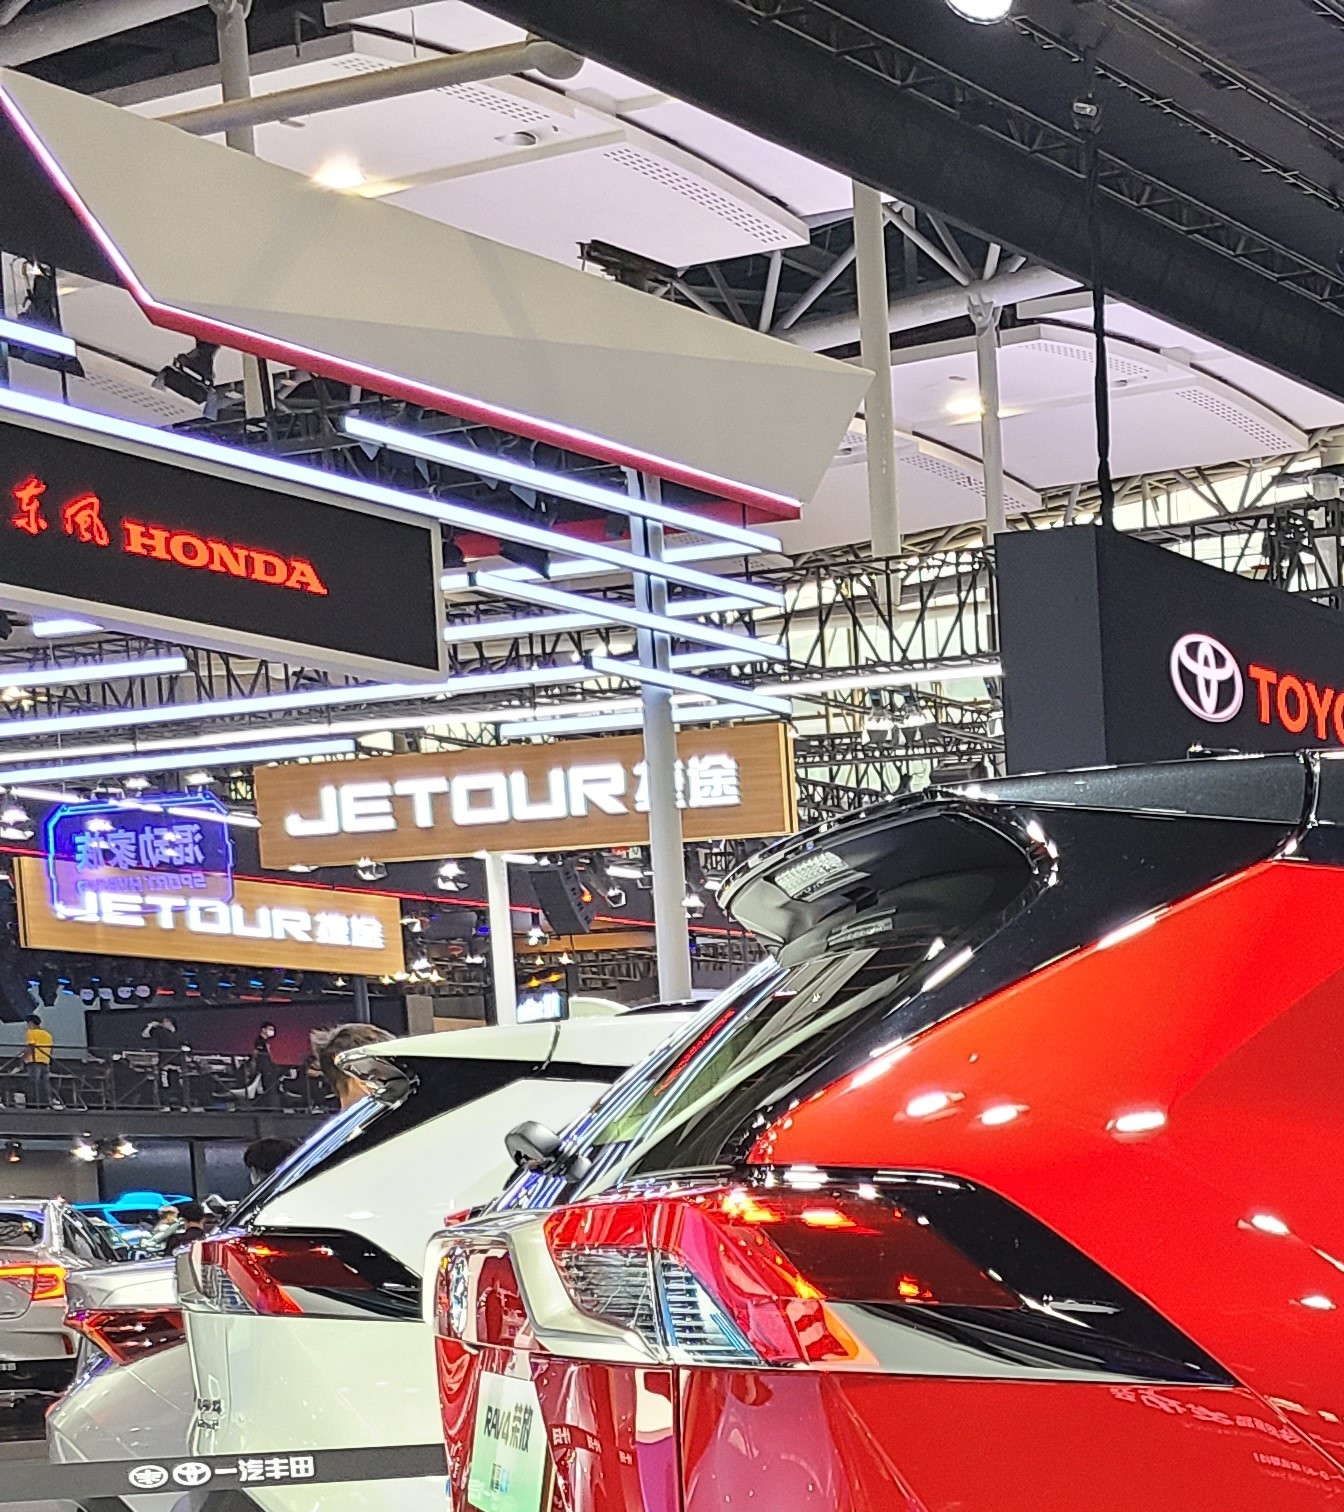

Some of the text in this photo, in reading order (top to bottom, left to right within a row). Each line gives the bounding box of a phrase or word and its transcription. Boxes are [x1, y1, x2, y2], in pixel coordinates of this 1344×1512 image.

[122, 519, 329, 595] HONDA
[285, 762, 629, 838] JETOUR
[55, 890, 314, 942] JETOUR
[214, 1456, 315, 1482] 一汽丰田
